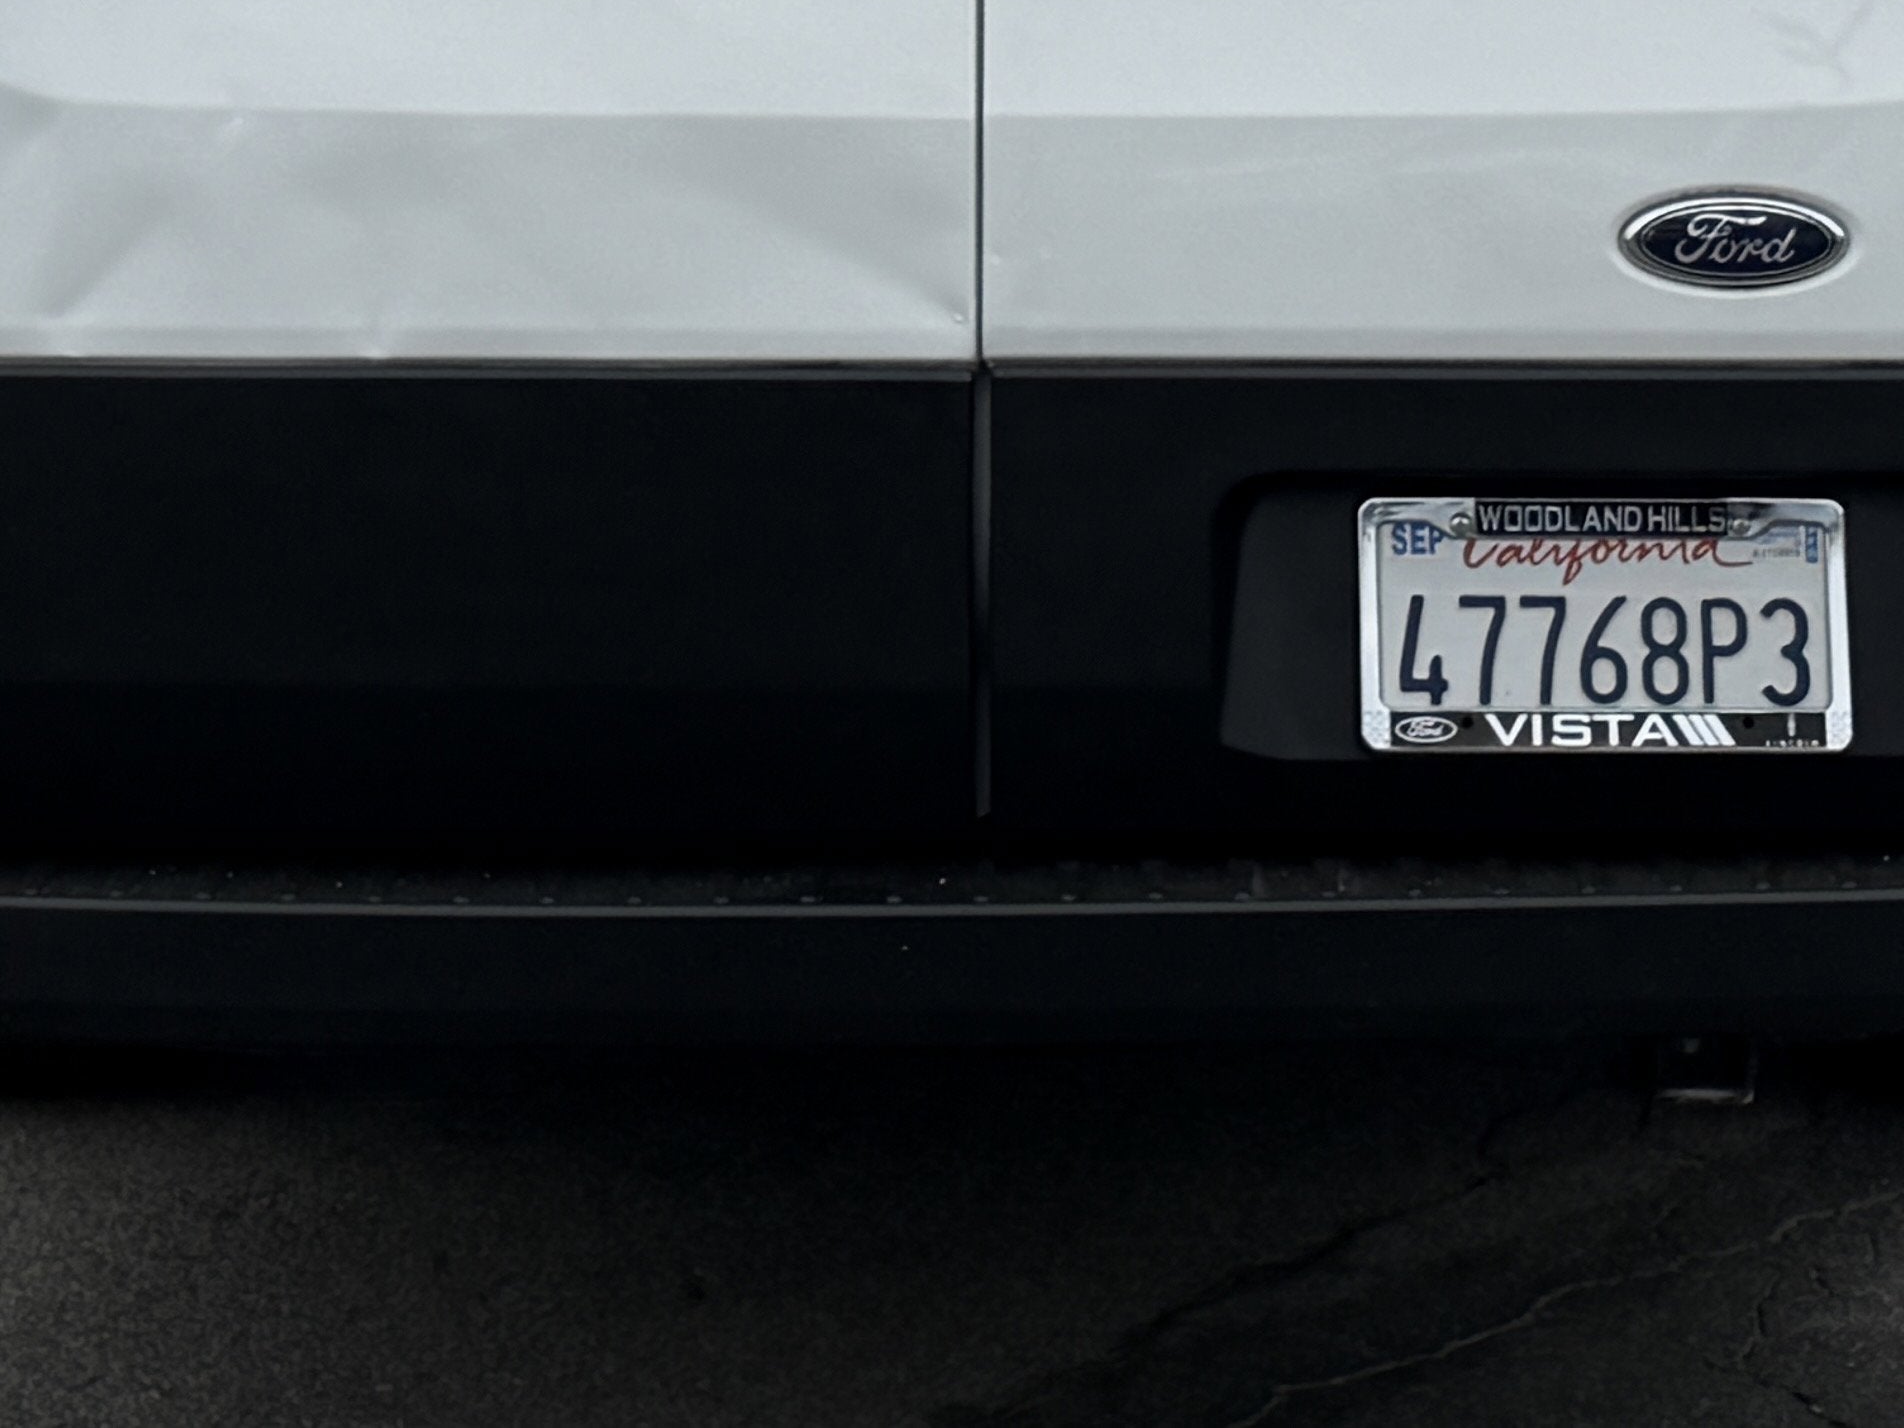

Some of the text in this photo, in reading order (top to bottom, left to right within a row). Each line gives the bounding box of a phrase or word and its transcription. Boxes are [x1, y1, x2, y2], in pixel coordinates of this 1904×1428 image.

[1674, 213, 1796, 264] Ford
[1478, 505, 1725, 532] WOODLAND HILLS
[1398, 595, 1811, 707] 47768P3
[1485, 714, 1679, 746] VISTA
